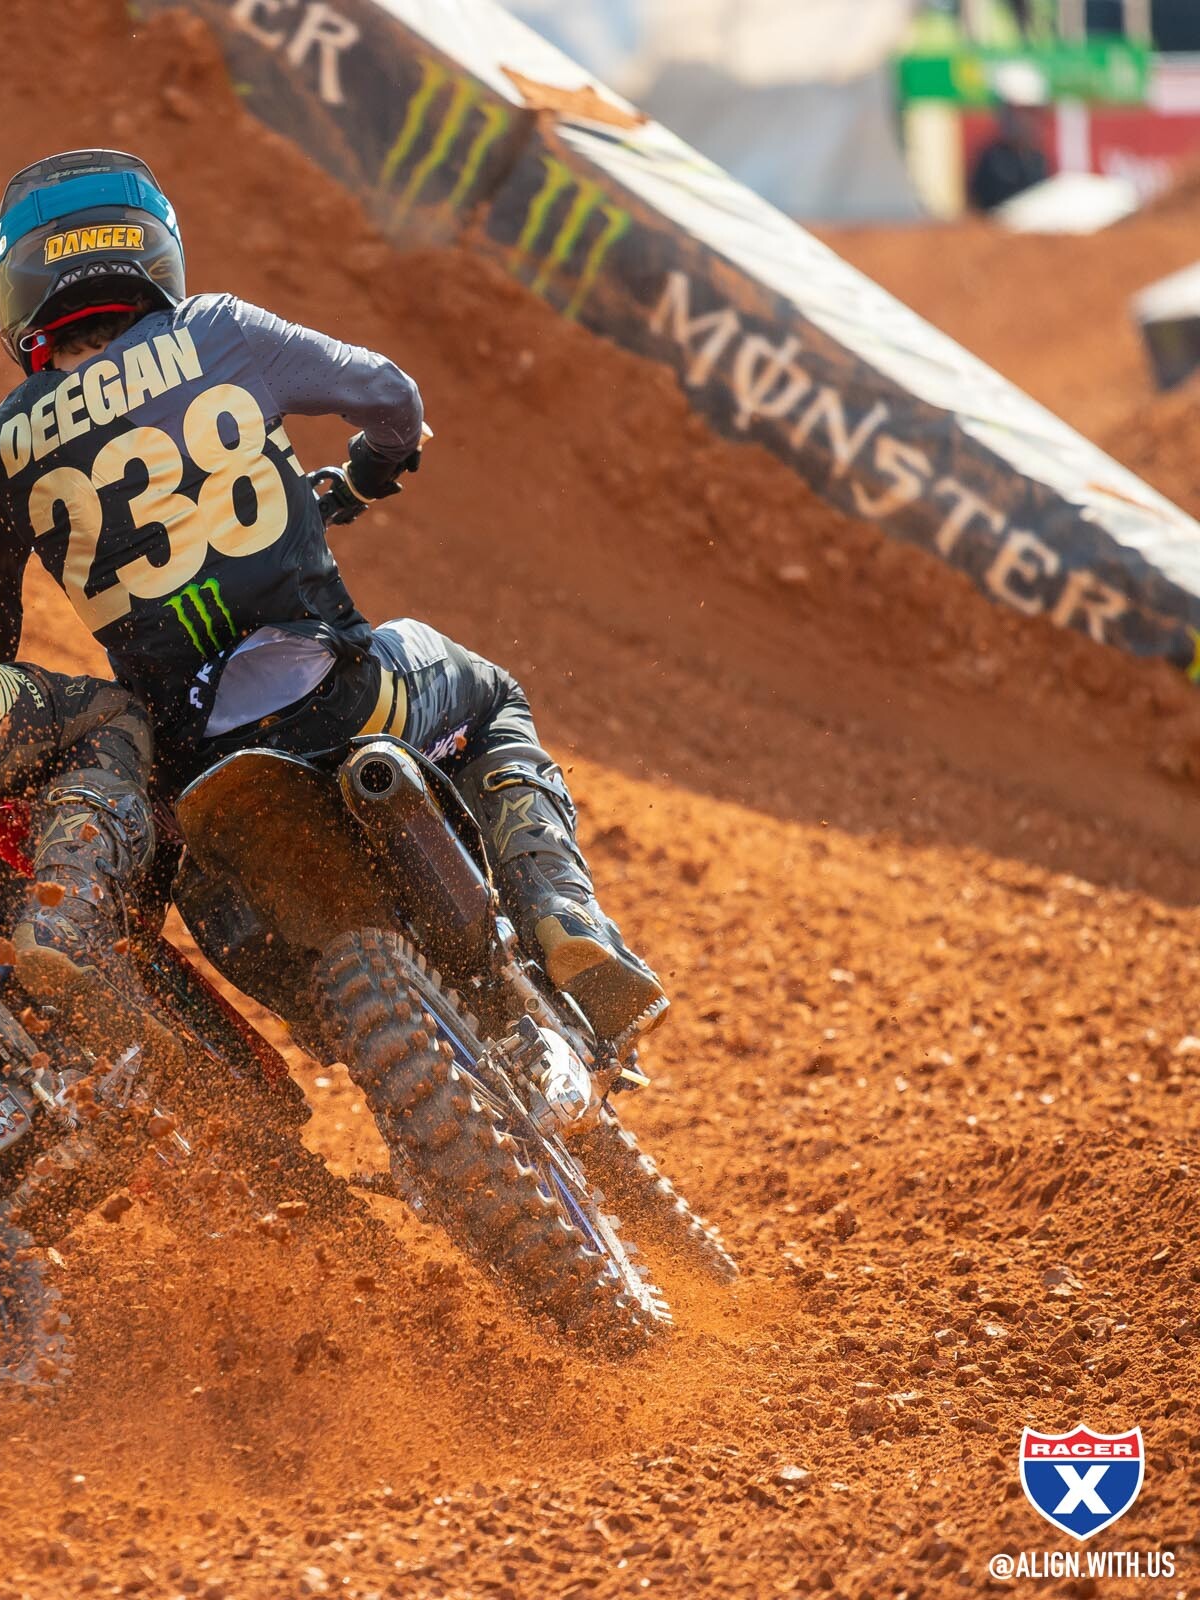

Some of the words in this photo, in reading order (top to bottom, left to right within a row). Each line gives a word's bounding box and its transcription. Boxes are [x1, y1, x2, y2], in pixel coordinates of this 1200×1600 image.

[45, 225, 144, 263] DANGER
[0, 328, 202, 478] DEEGAN
[28, 383, 288, 633] 238
